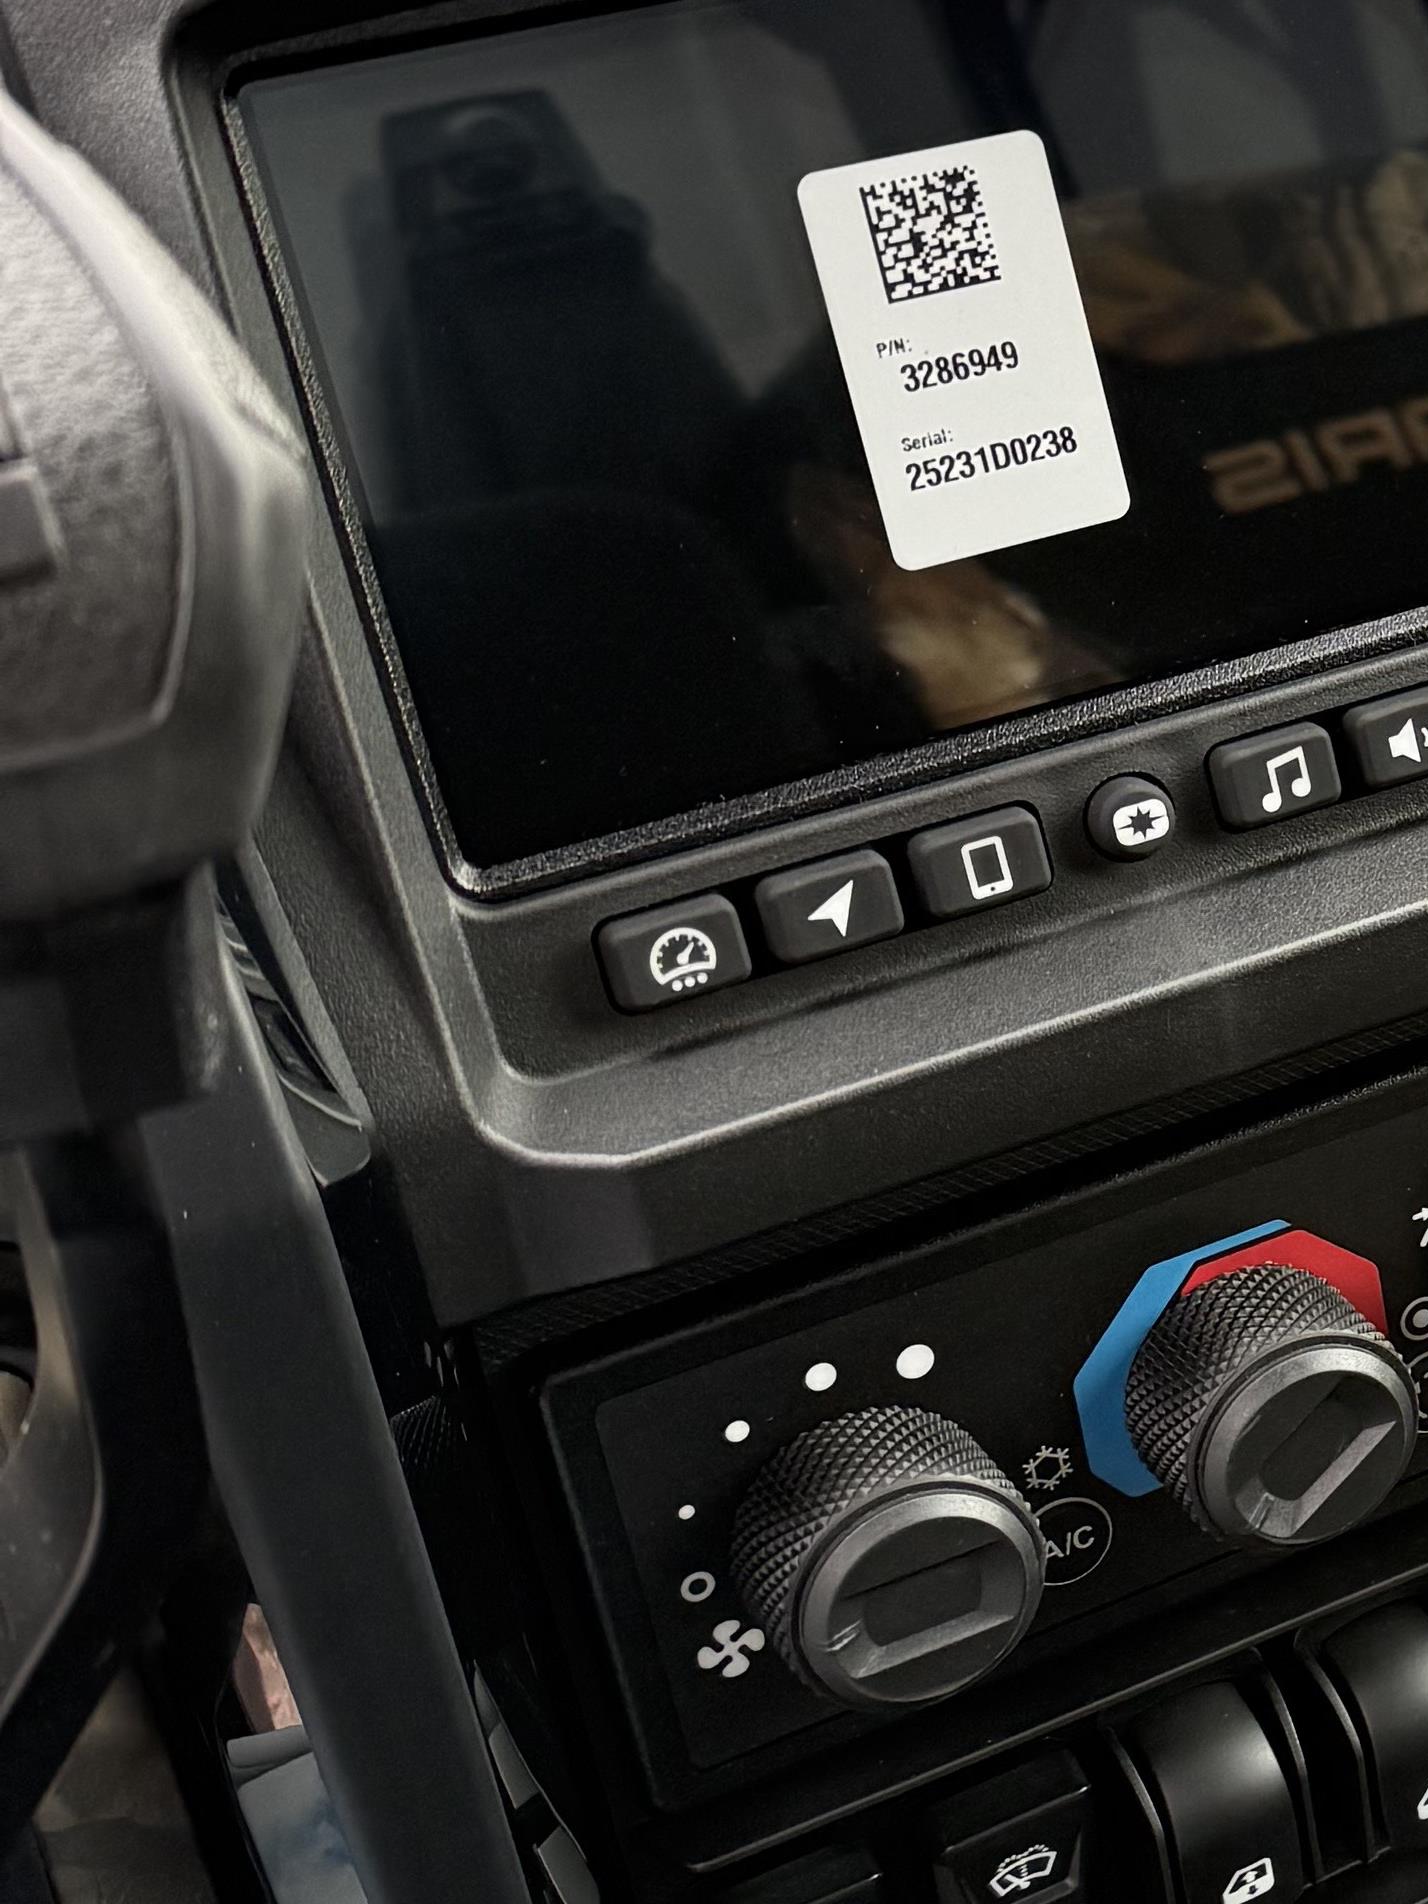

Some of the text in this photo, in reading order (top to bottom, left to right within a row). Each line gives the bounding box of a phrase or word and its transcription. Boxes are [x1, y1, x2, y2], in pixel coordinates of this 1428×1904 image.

[876, 336, 913, 359] P/N:
[900, 340, 1019, 393] 3286949
[901, 427, 955, 453] Serial:
[905, 425, 1078, 492] 25231D0238
[1046, 1524, 1095, 1558] A/C
